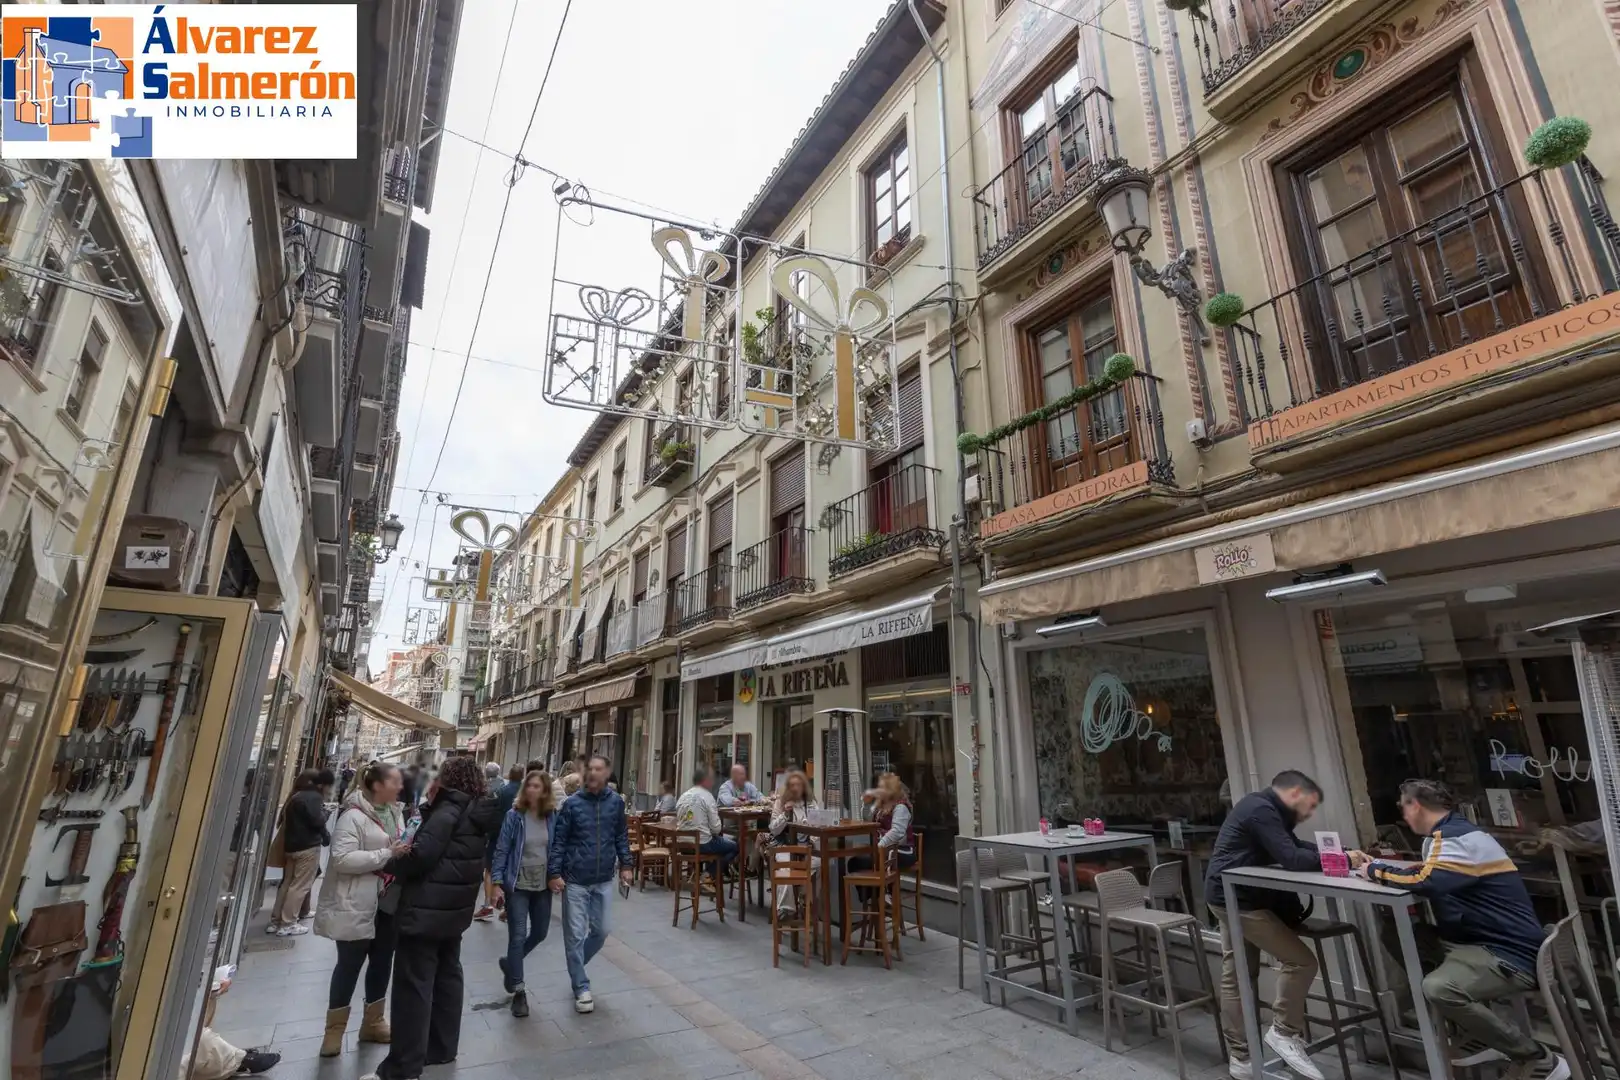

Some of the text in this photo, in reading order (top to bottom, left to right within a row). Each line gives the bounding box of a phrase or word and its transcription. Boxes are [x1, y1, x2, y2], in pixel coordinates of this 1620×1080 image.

[1282, 302, 1620, 432] APARTAMENTOS TURÍSTICOS
[997, 467, 1143, 530] CASA CATEDRAL
[1215, 548, 1249, 570] ROLLO
[861, 613, 924, 639] LA RIFFEÑA
[758, 675, 777, 698] LA
[781, 658, 850, 696] RIFFEÑA
